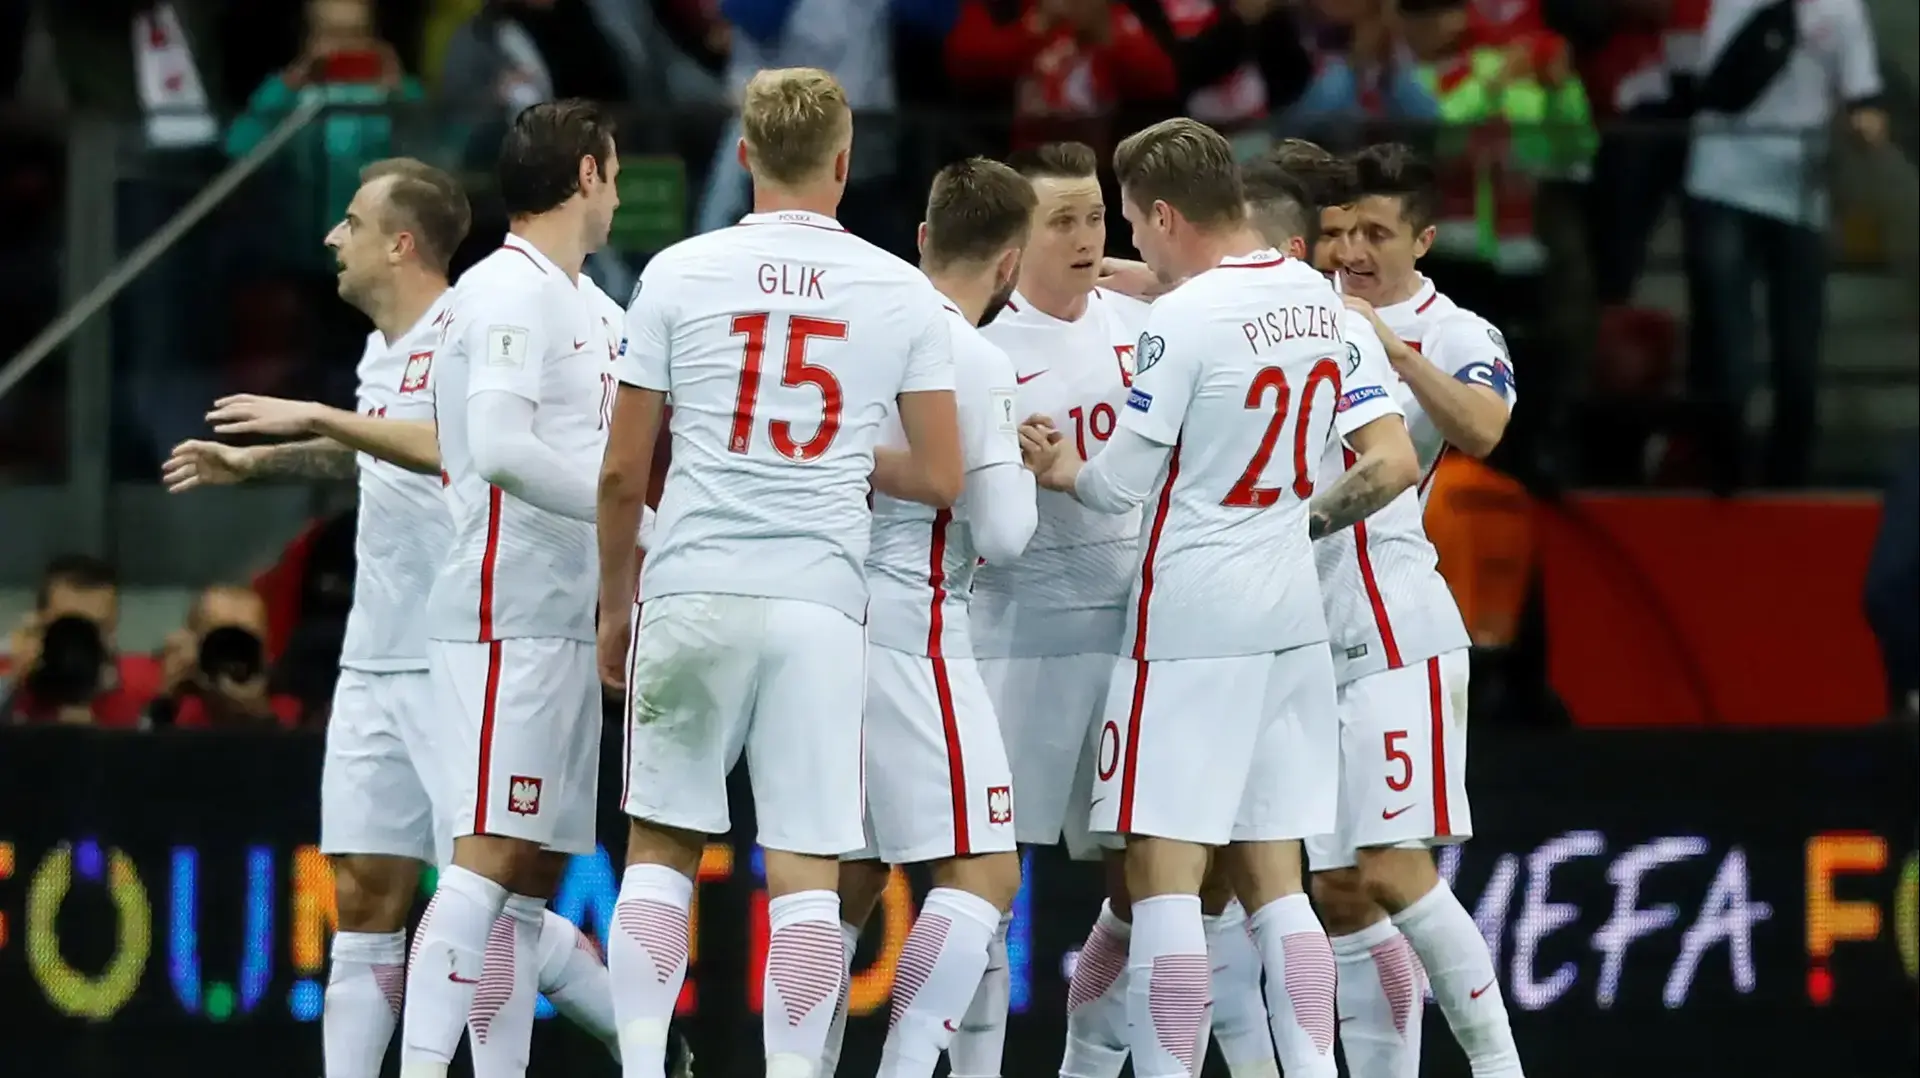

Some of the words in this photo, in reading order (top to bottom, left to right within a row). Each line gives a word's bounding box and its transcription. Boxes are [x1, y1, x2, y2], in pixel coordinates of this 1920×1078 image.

[757, 263, 826, 300] GLIK
[1242, 305, 1342, 355] PISZCZEK
[728, 312, 850, 464] 15
[1468, 366, 1493, 386] C
[1219, 357, 1342, 509] 20
[1383, 729, 1413, 792] 5
[1424, 830, 1774, 1010] UEFA
[1805, 830, 1919, 1006] F
